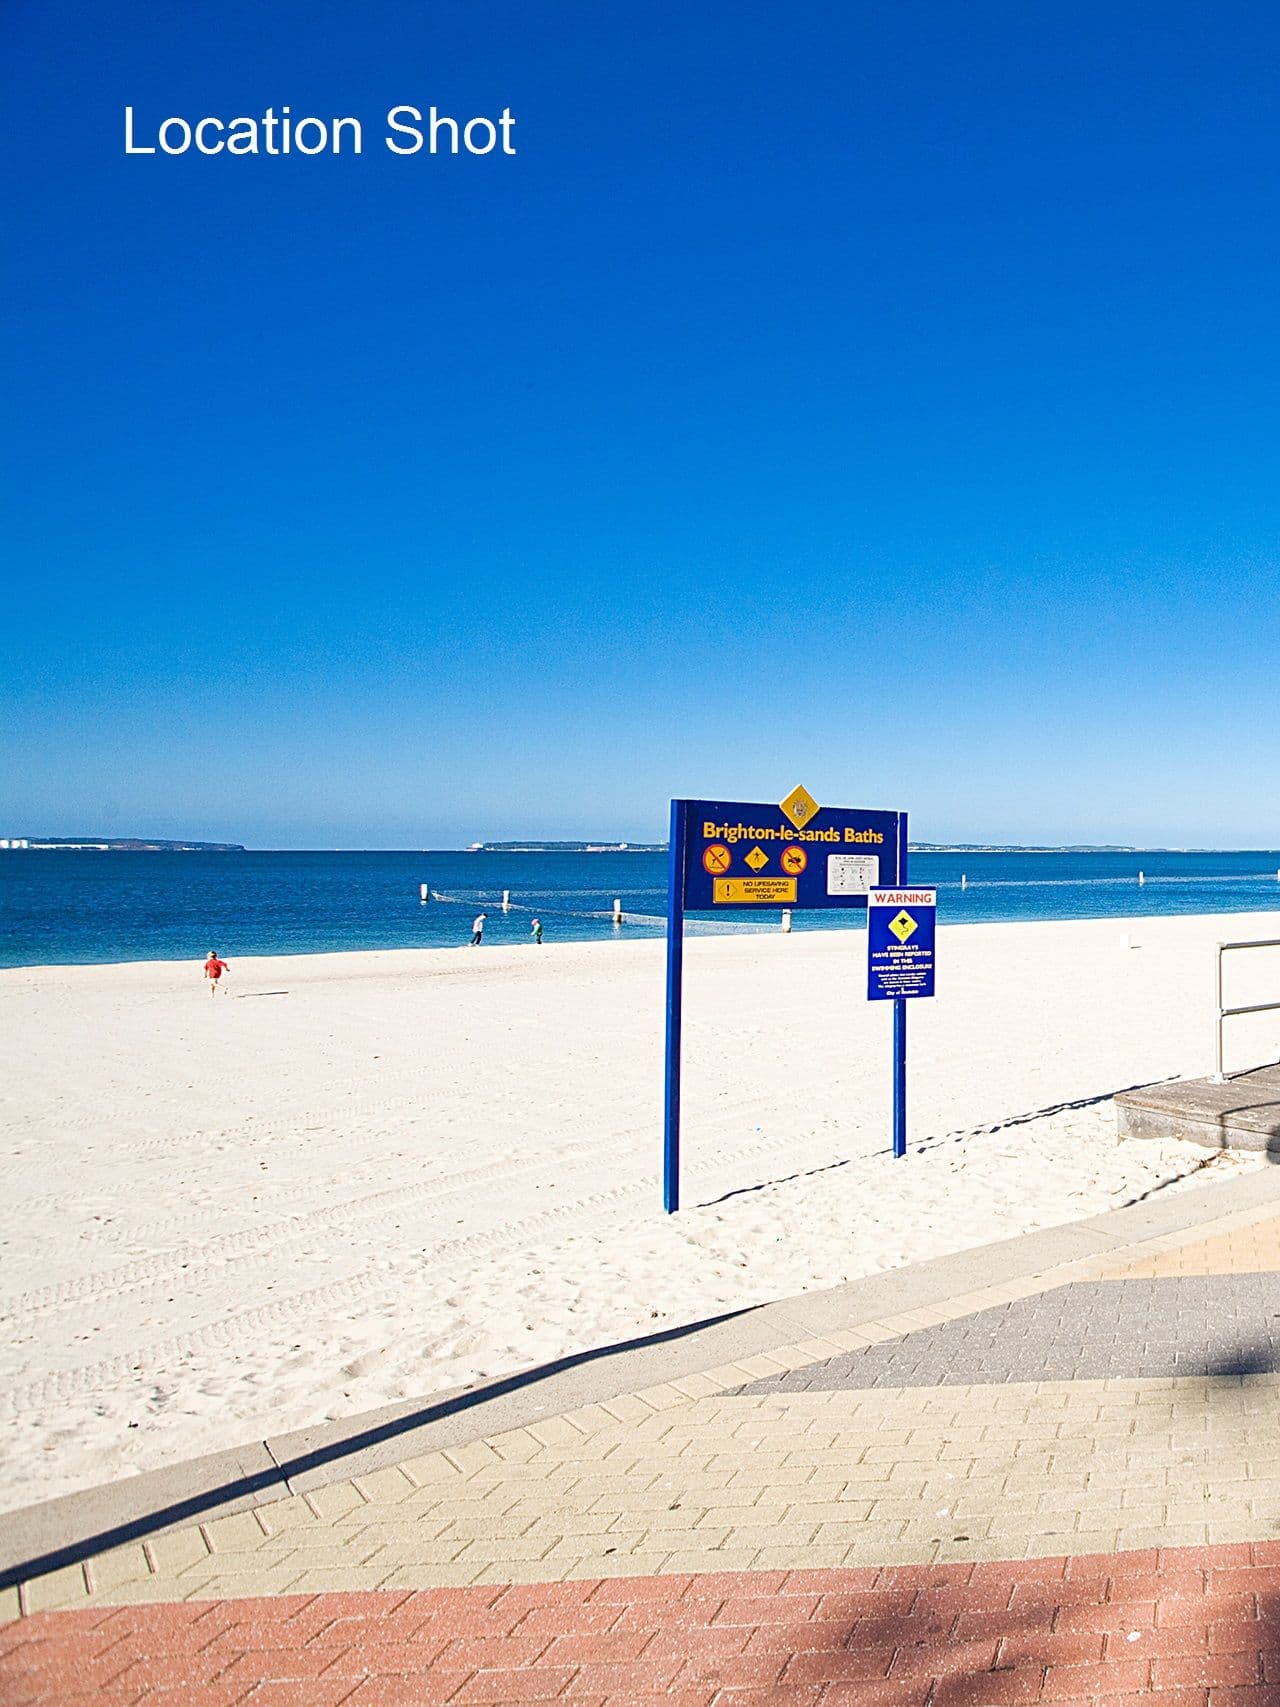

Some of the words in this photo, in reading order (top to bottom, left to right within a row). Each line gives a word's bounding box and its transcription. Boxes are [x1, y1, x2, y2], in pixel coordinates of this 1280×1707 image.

[703, 821, 840, 843] Brighton-le-sands
[844, 828, 884, 844] Baths
[874, 893, 932, 904] WARNING
